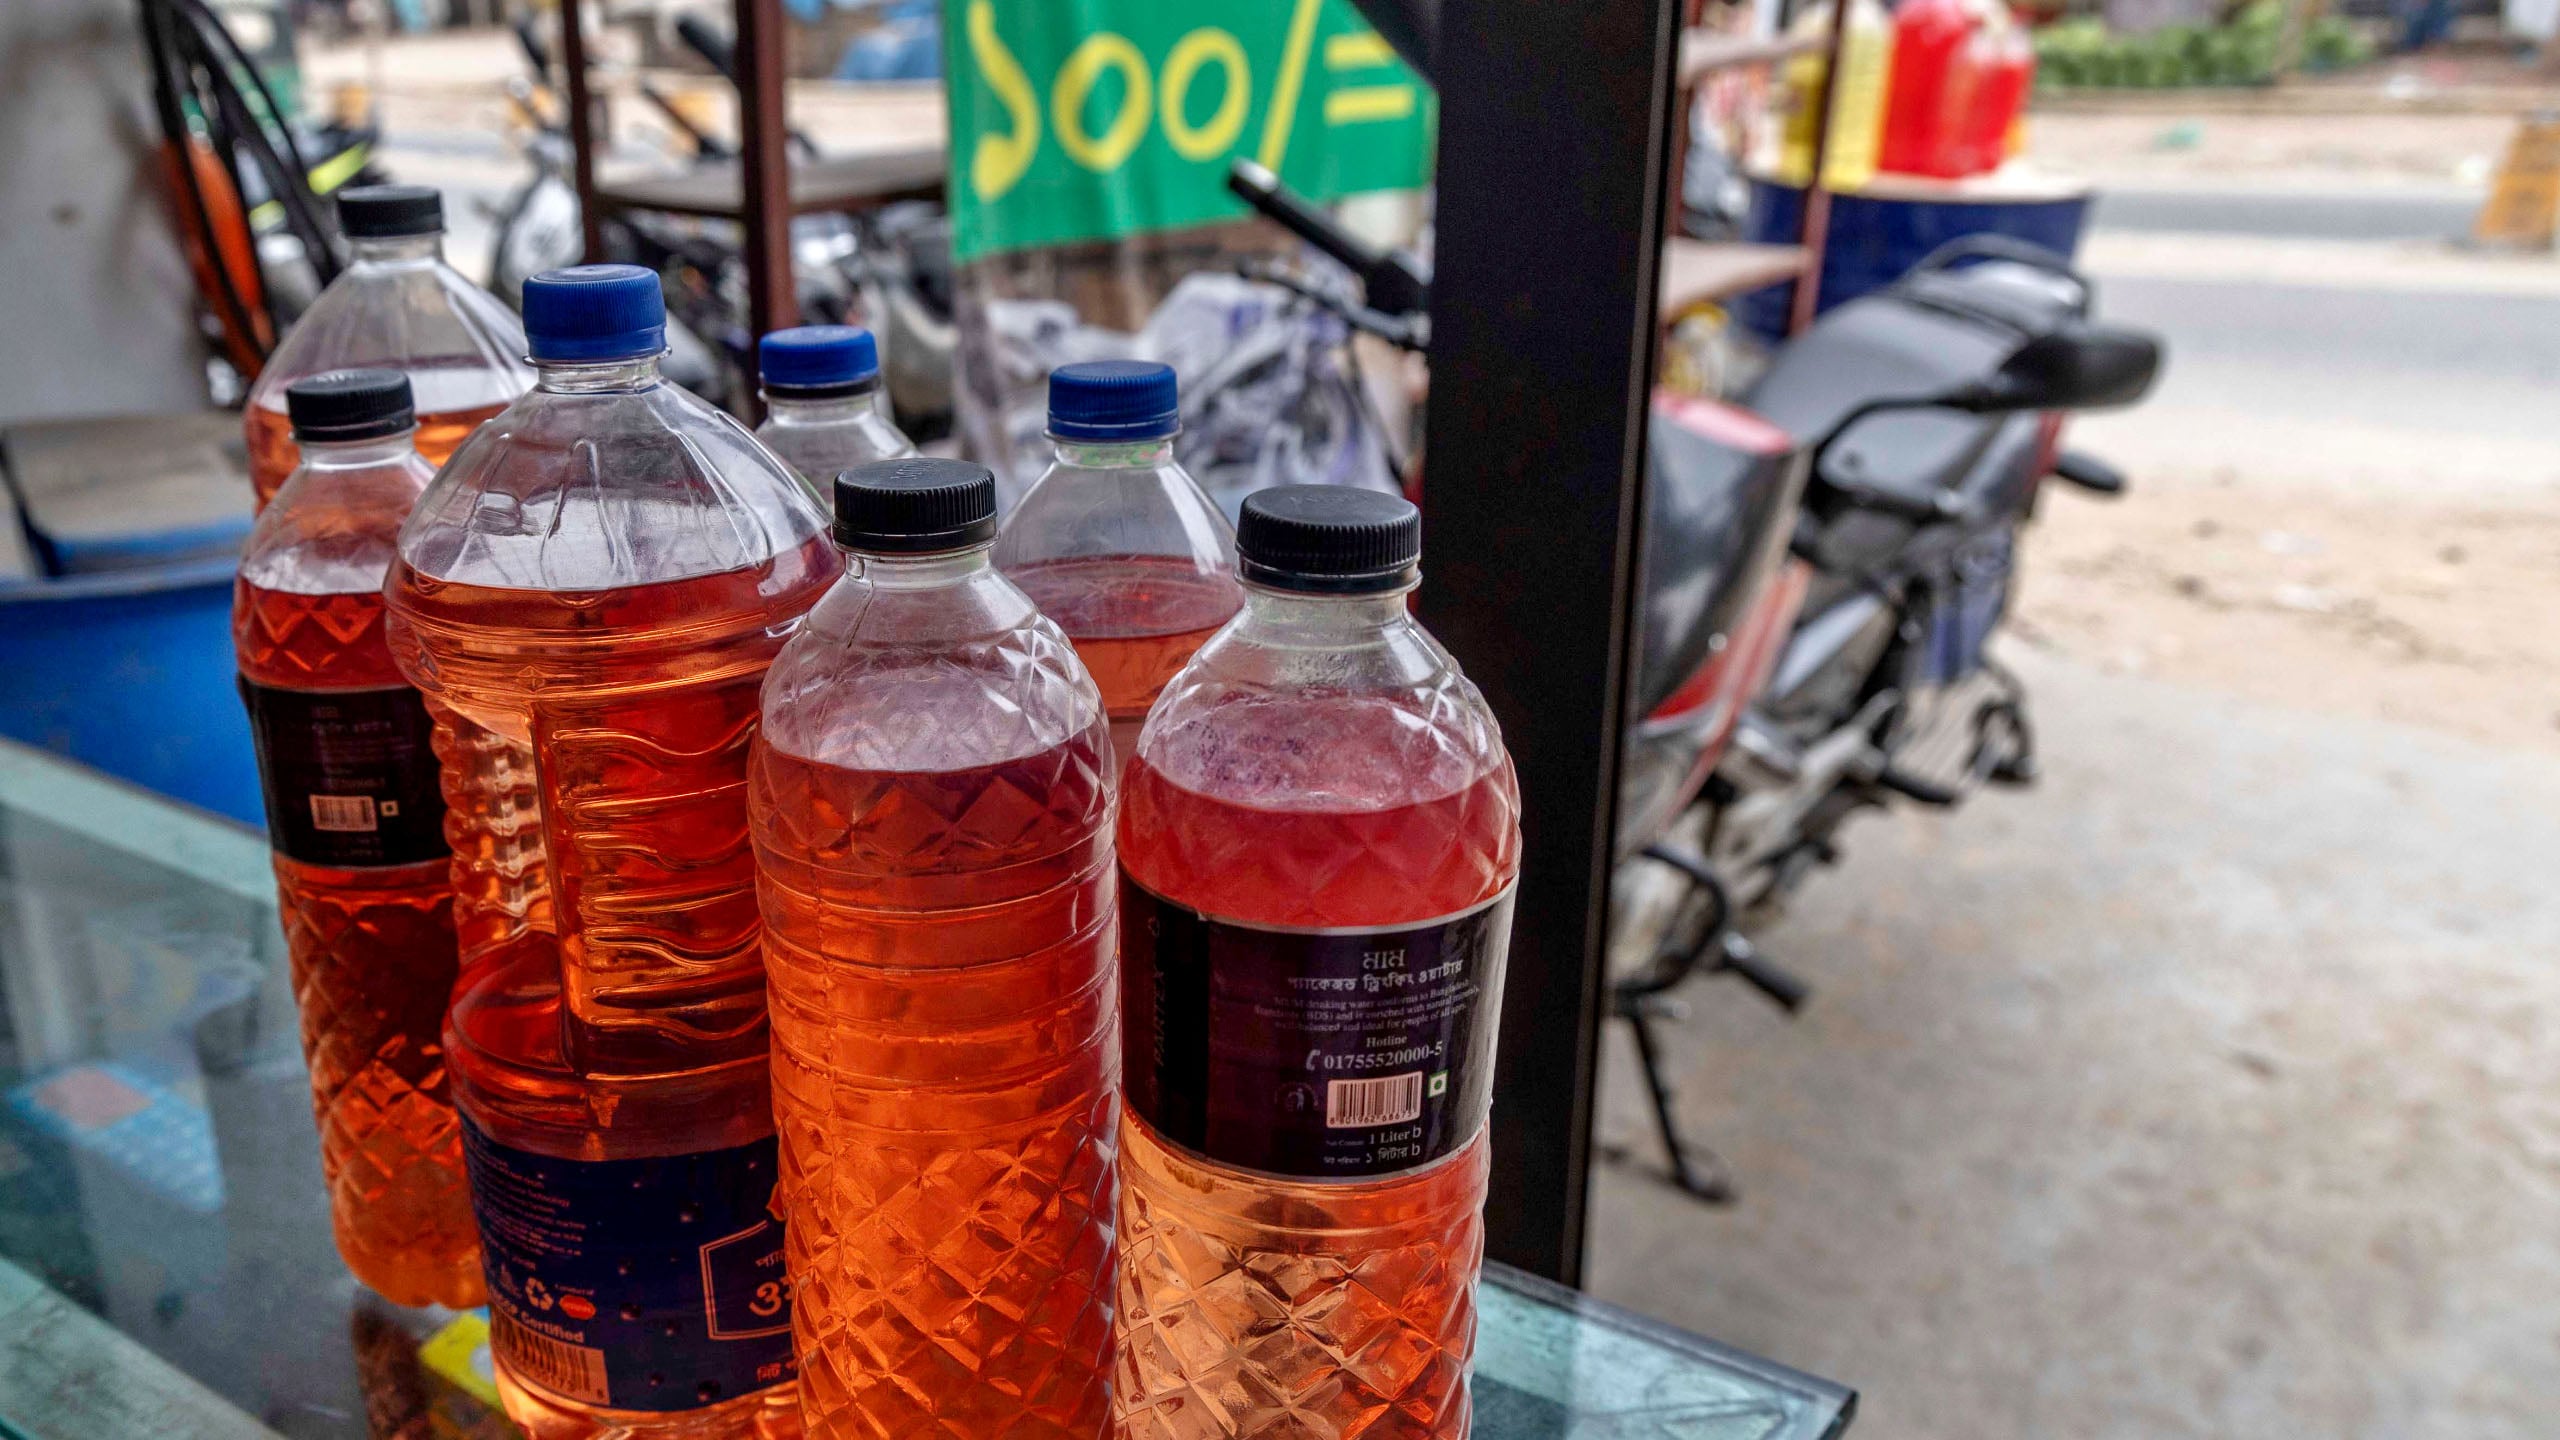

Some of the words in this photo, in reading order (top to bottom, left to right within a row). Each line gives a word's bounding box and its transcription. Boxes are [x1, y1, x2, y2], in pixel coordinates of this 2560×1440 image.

[1362, 948, 1406, 971] মাম
[1365, 1034, 1408, 1048] Hotline
[1323, 1040, 1443, 1070] 01755520000-5
[1368, 1132, 1376, 1145] 1
[1379, 1129, 1411, 1144] Liter
[520, 1309, 585, 1344] Certified
